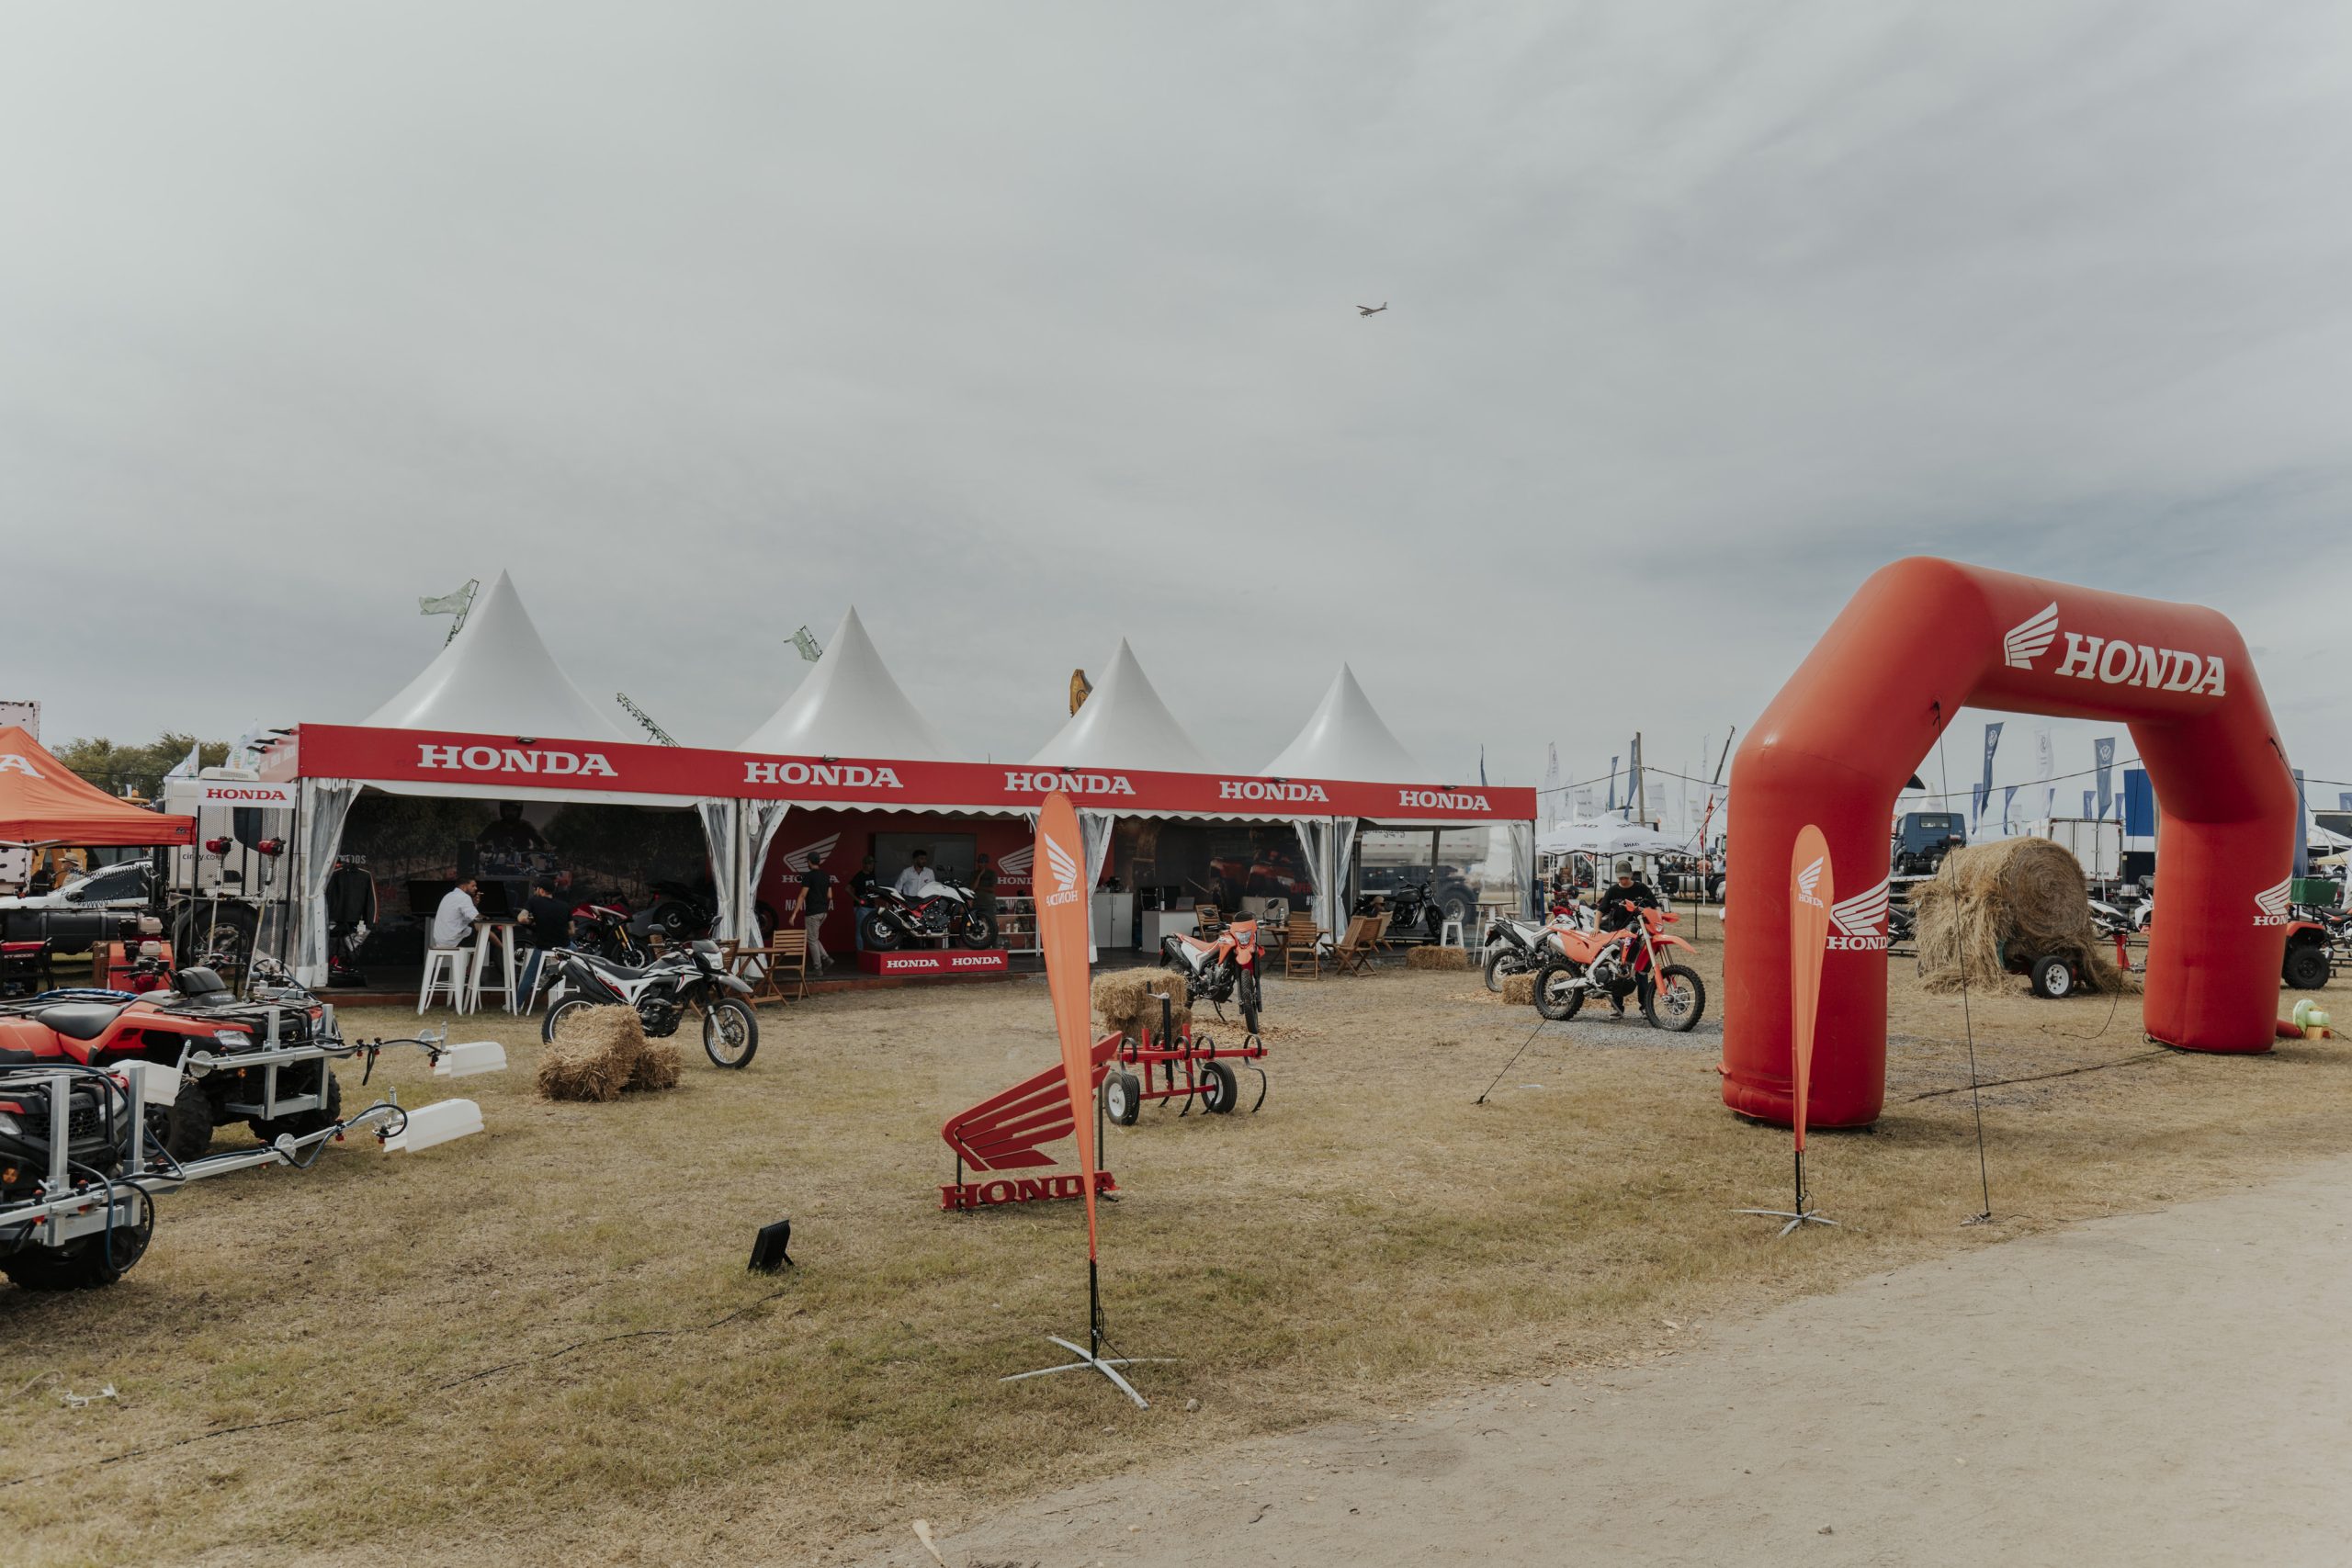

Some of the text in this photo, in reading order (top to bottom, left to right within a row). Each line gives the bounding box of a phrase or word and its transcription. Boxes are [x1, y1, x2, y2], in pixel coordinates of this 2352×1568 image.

[2054, 632, 2227, 696] HONDA
[416, 744, 619, 777] HONDA
[743, 761, 904, 788] HONDA
[1004, 772, 1136, 795] HONDA
[206, 788, 287, 801] HONDA
[1219, 781, 1329, 803] HONDA
[1398, 790, 1492, 812] HONDA
[781, 874, 841, 884] HOA
[997, 876, 1033, 885] HOND
[2253, 915, 2288, 926] HON
[1826, 936, 1887, 950] HOND
[887, 959, 940, 968] HONDA
[952, 956, 1002, 966] HONDA
[937, 1171, 1120, 1210] HONDA
